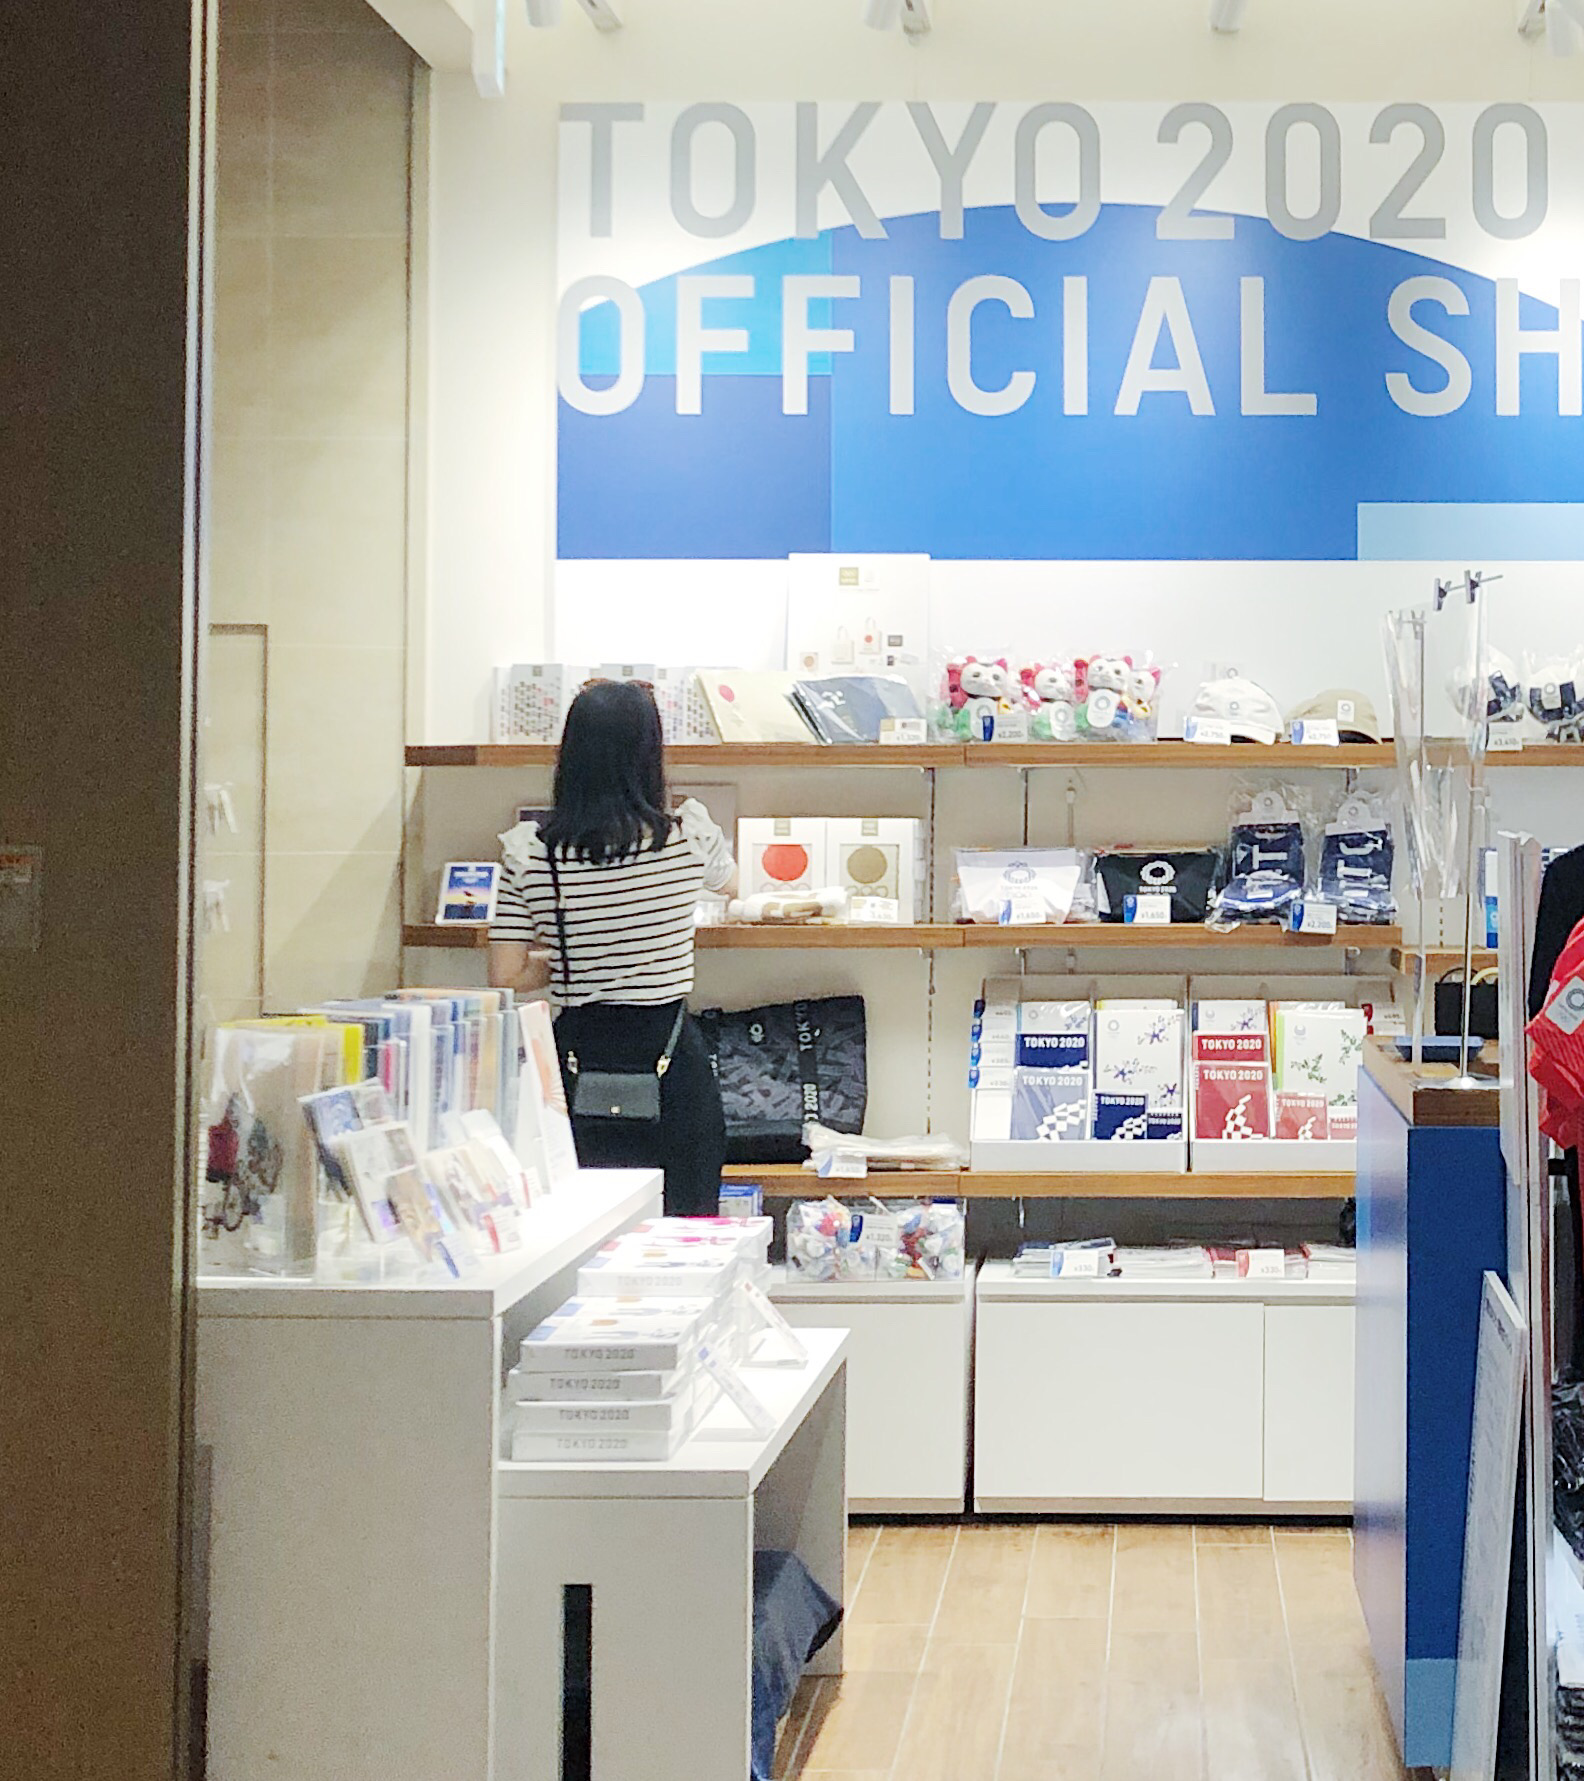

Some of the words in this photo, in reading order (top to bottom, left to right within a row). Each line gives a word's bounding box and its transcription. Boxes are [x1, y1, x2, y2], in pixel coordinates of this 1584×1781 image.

[558, 102, 1102, 242] TOKYO
[1156, 102, 1550, 242] 2020
[556, 274, 1319, 418] OFFICIAL
[1024, 1036, 1057, 1049] TOKYO
[1059, 1036, 1085, 1049] 2020
[1201, 1038, 1236, 1051] TOKYO
[1237, 1038, 1263, 1051] 2020
[1022, 1075, 1057, 1087] TOKYO
[1057, 1075, 1083, 1087] 2020
[1203, 1069, 1237, 1081] TOKYO
[1238, 1069, 1264, 1081] 2020
[1101, 1096, 1125, 1106] TOKYO
[1125, 1096, 1146, 1106] 2020
[564, 1348, 603, 1360] TOKYO
[605, 1348, 635, 1360] 2020
[550, 1378, 589, 1390] TOKYO
[591, 1378, 621, 1390] 2020
[559, 1409, 598, 1421] TOKYO
[600, 1409, 630, 1421] 2020
[557, 1438, 597, 1449] TOKYO
[599, 1438, 629, 1449] 2020
